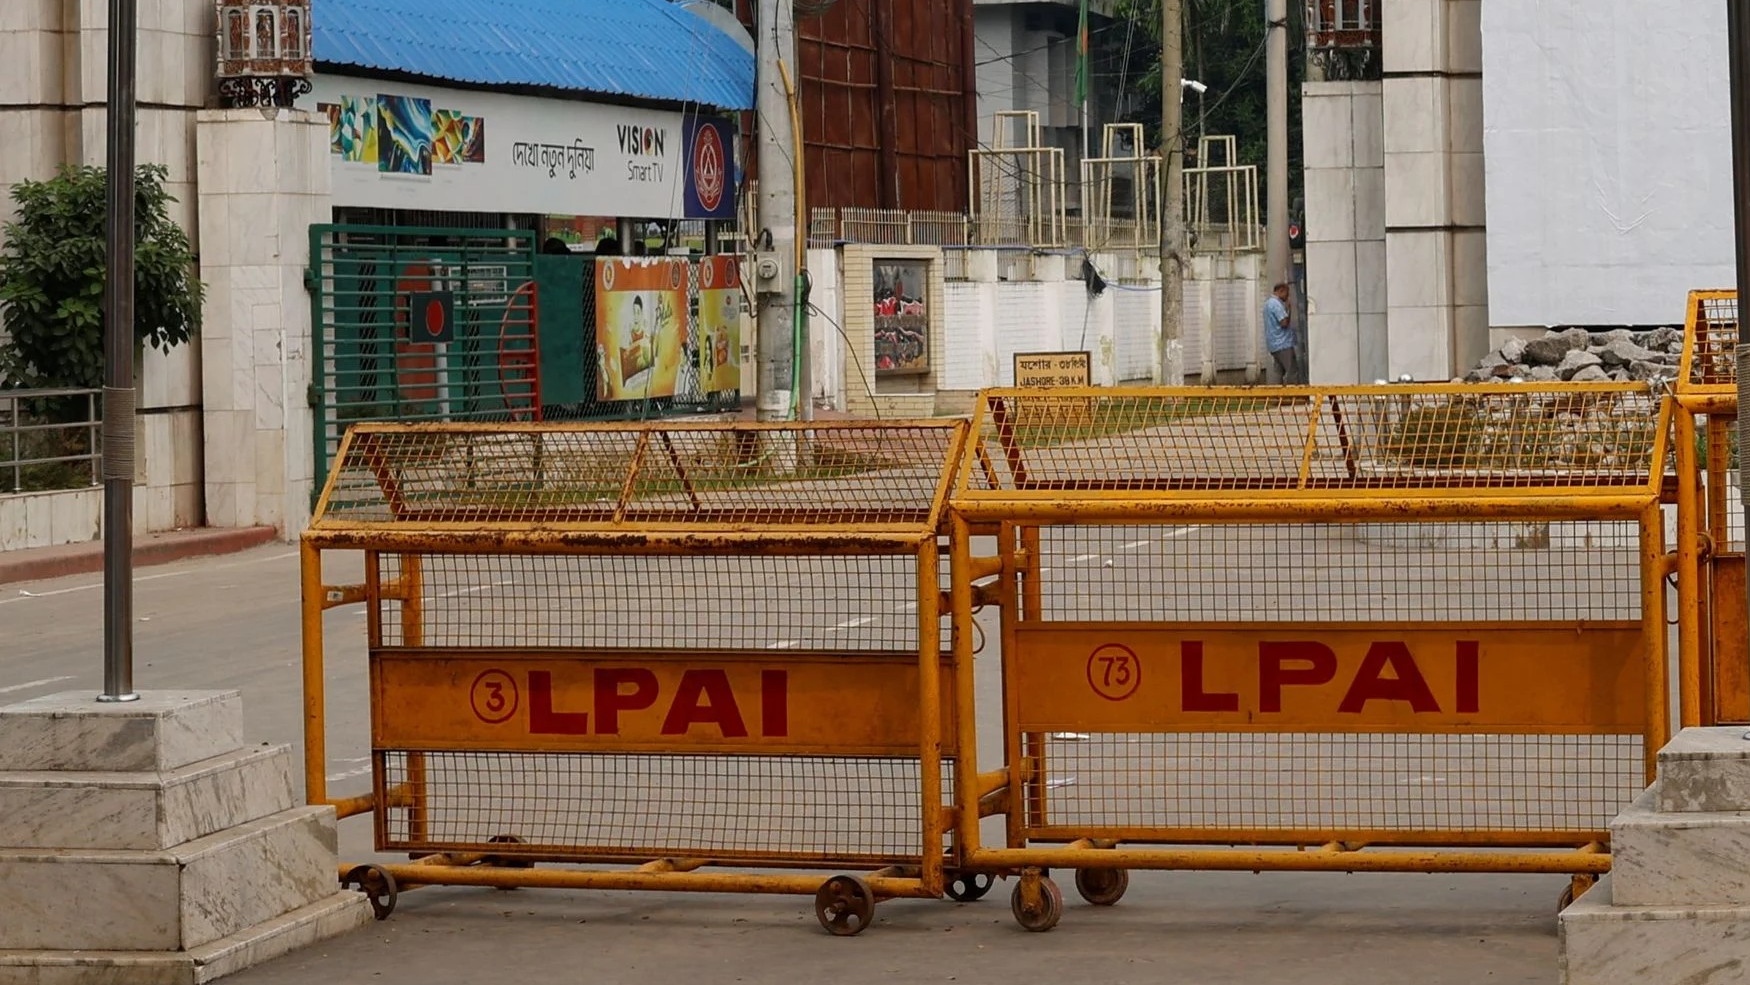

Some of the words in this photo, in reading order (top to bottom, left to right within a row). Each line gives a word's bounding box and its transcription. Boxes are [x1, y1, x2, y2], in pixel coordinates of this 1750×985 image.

[512, 142, 539, 167] দেখো
[541, 143, 565, 178] নতুন
[617, 124, 664, 157] VISION
[485, 682, 506, 712] 3
[528, 667, 788, 737] LPAI
[1098, 656, 1130, 686] 73
[1181, 640, 1479, 713] LPAI
